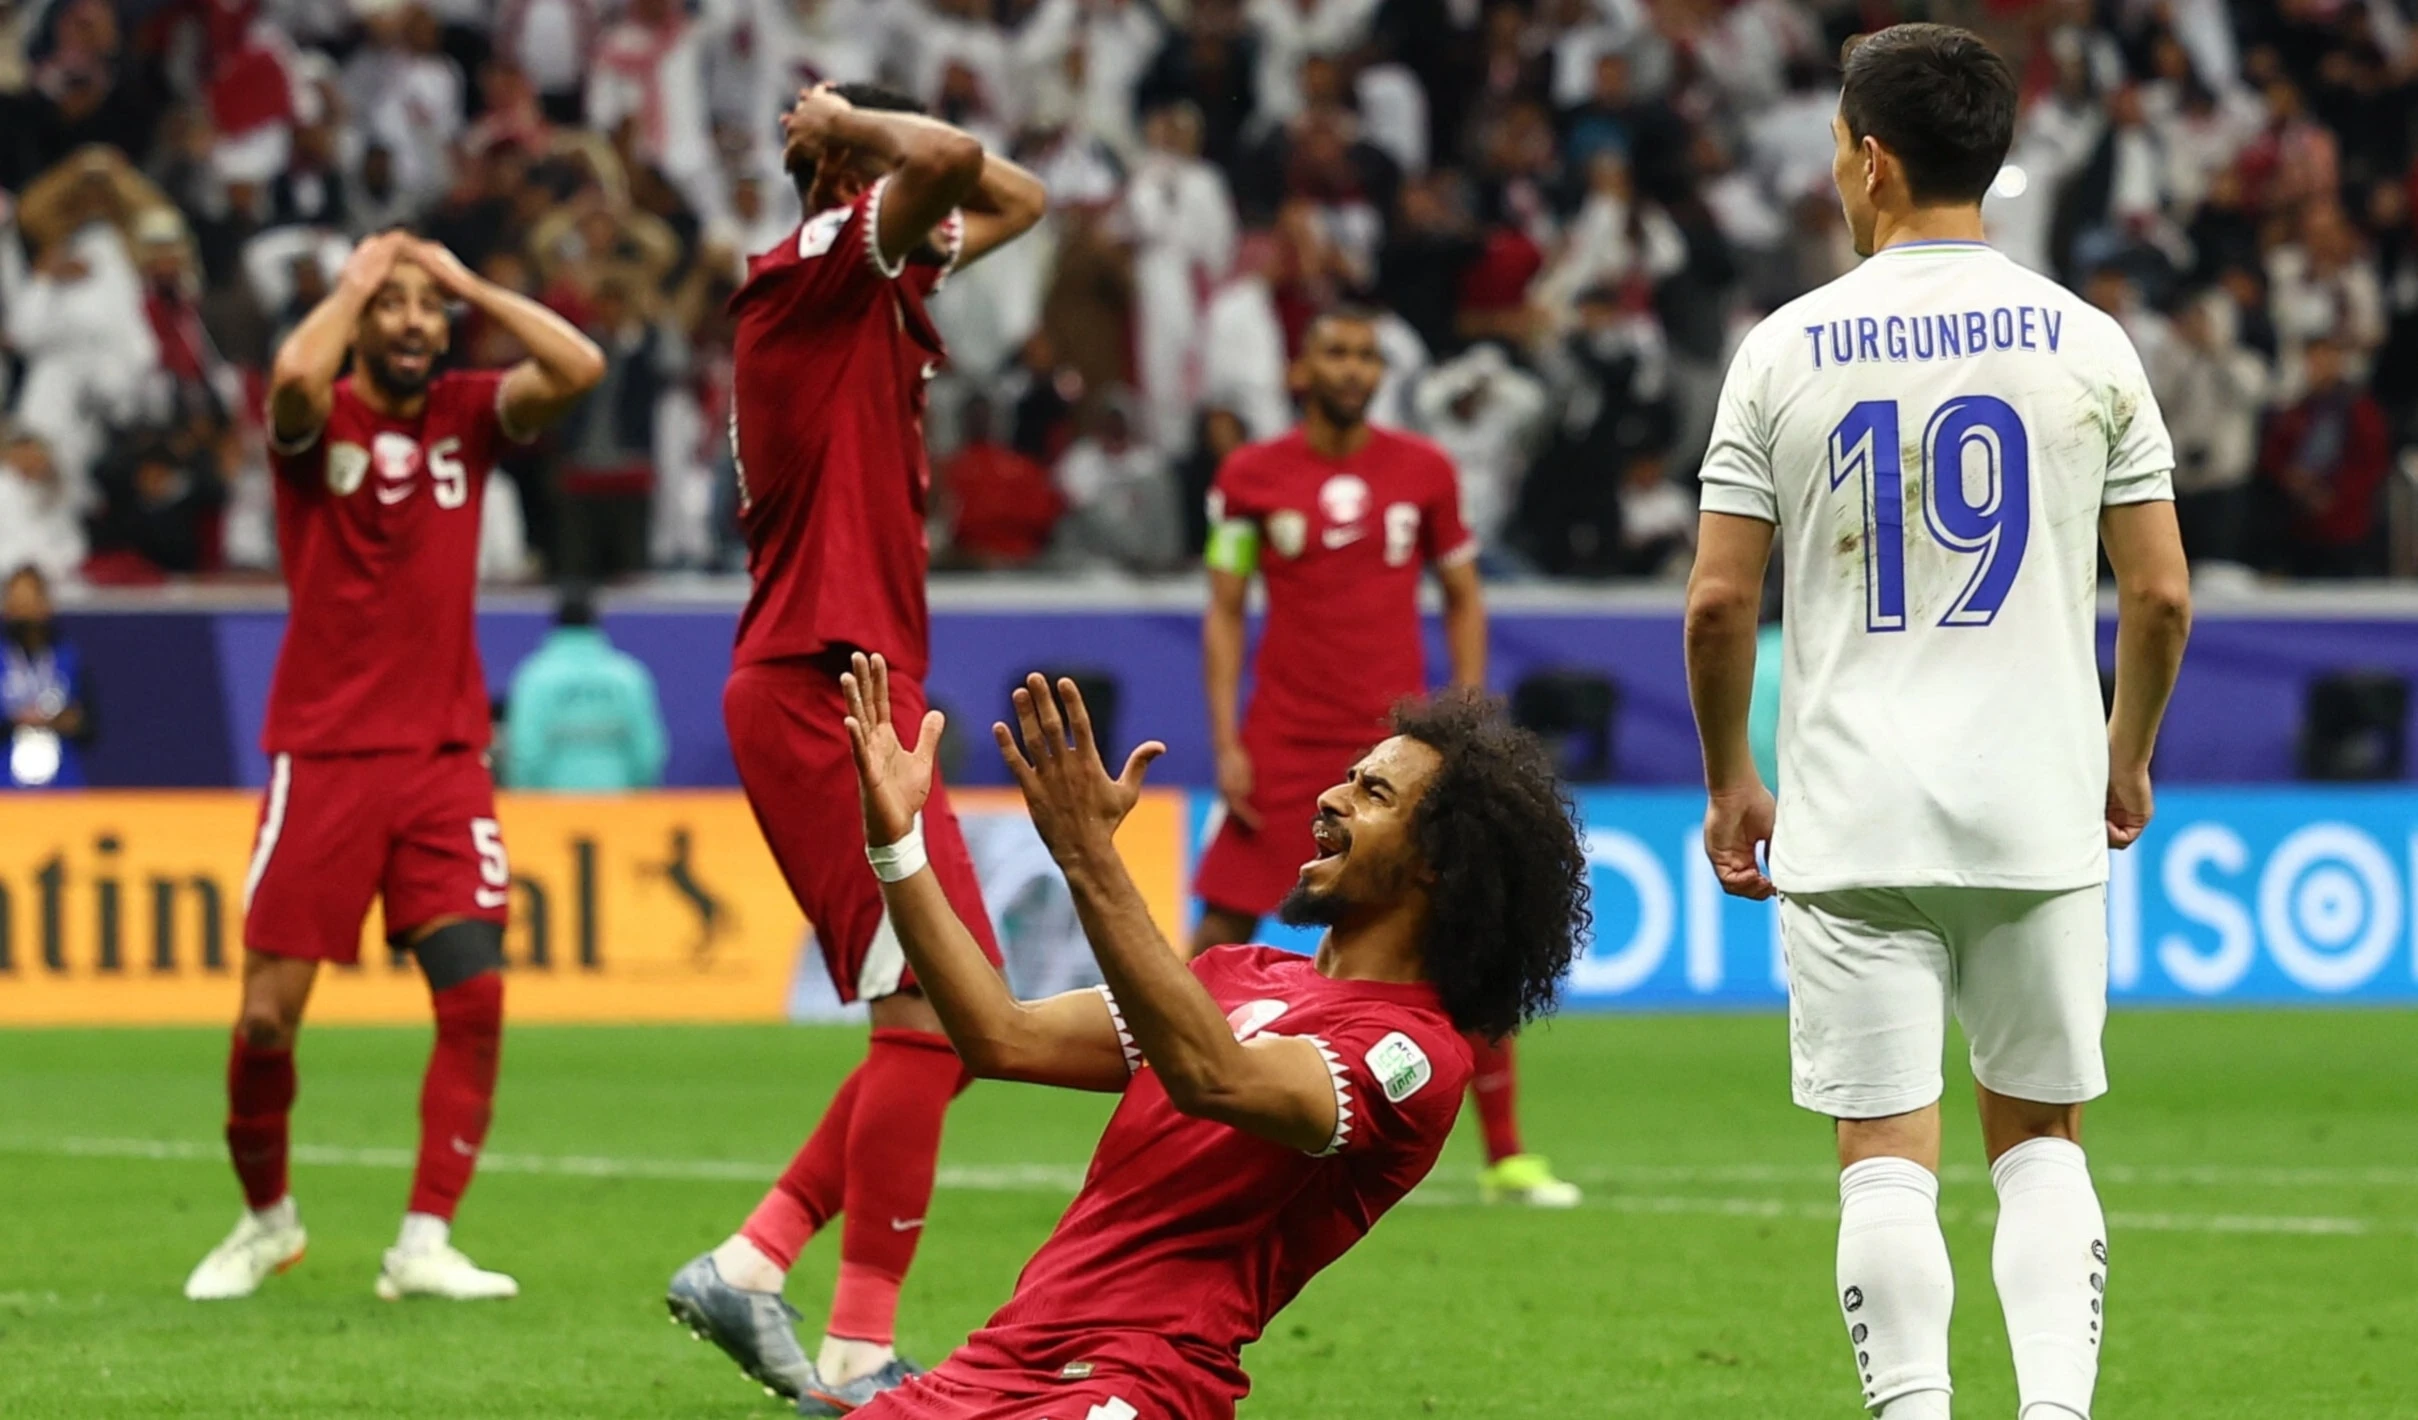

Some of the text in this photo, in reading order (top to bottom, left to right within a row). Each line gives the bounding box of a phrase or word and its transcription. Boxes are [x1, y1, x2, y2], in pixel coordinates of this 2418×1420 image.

[1804, 306, 2063, 370] TURGUNBOEV
[427, 436, 469, 509] 5
[1828, 394, 2031, 634] 19
[470, 816, 510, 887] 5
[2108, 821, 2418, 996] ISO
